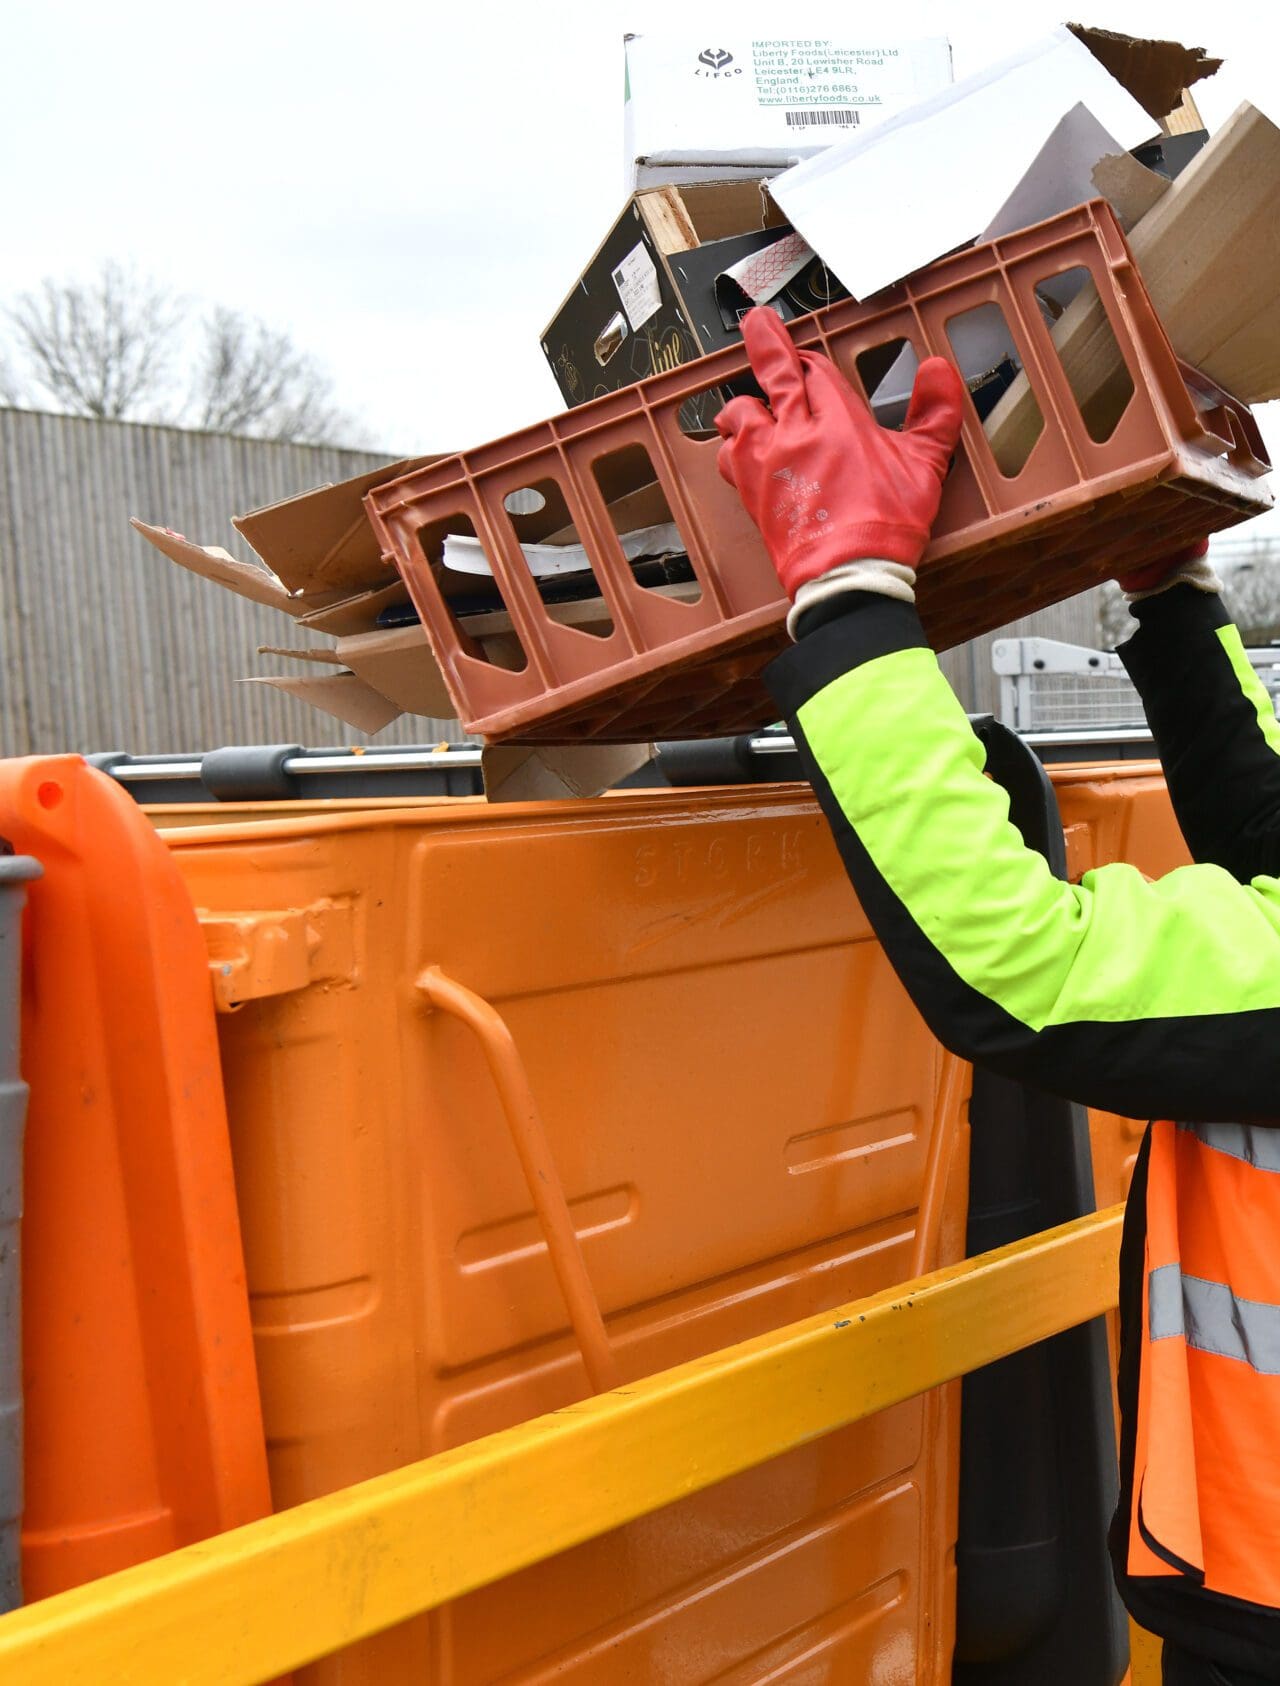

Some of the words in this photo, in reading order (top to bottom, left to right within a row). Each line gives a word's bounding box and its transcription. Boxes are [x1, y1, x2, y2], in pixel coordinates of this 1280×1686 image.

[752, 40, 812, 48] IMPORTED
[752, 49, 788, 58] Liberty
[882, 49, 899, 57] Ltd
[791, 58, 804, 66] 20
[856, 57, 884, 65] Road
[832, 85, 858, 93] 6863
[758, 94, 881, 103] www.libertyfoods.co.uk
